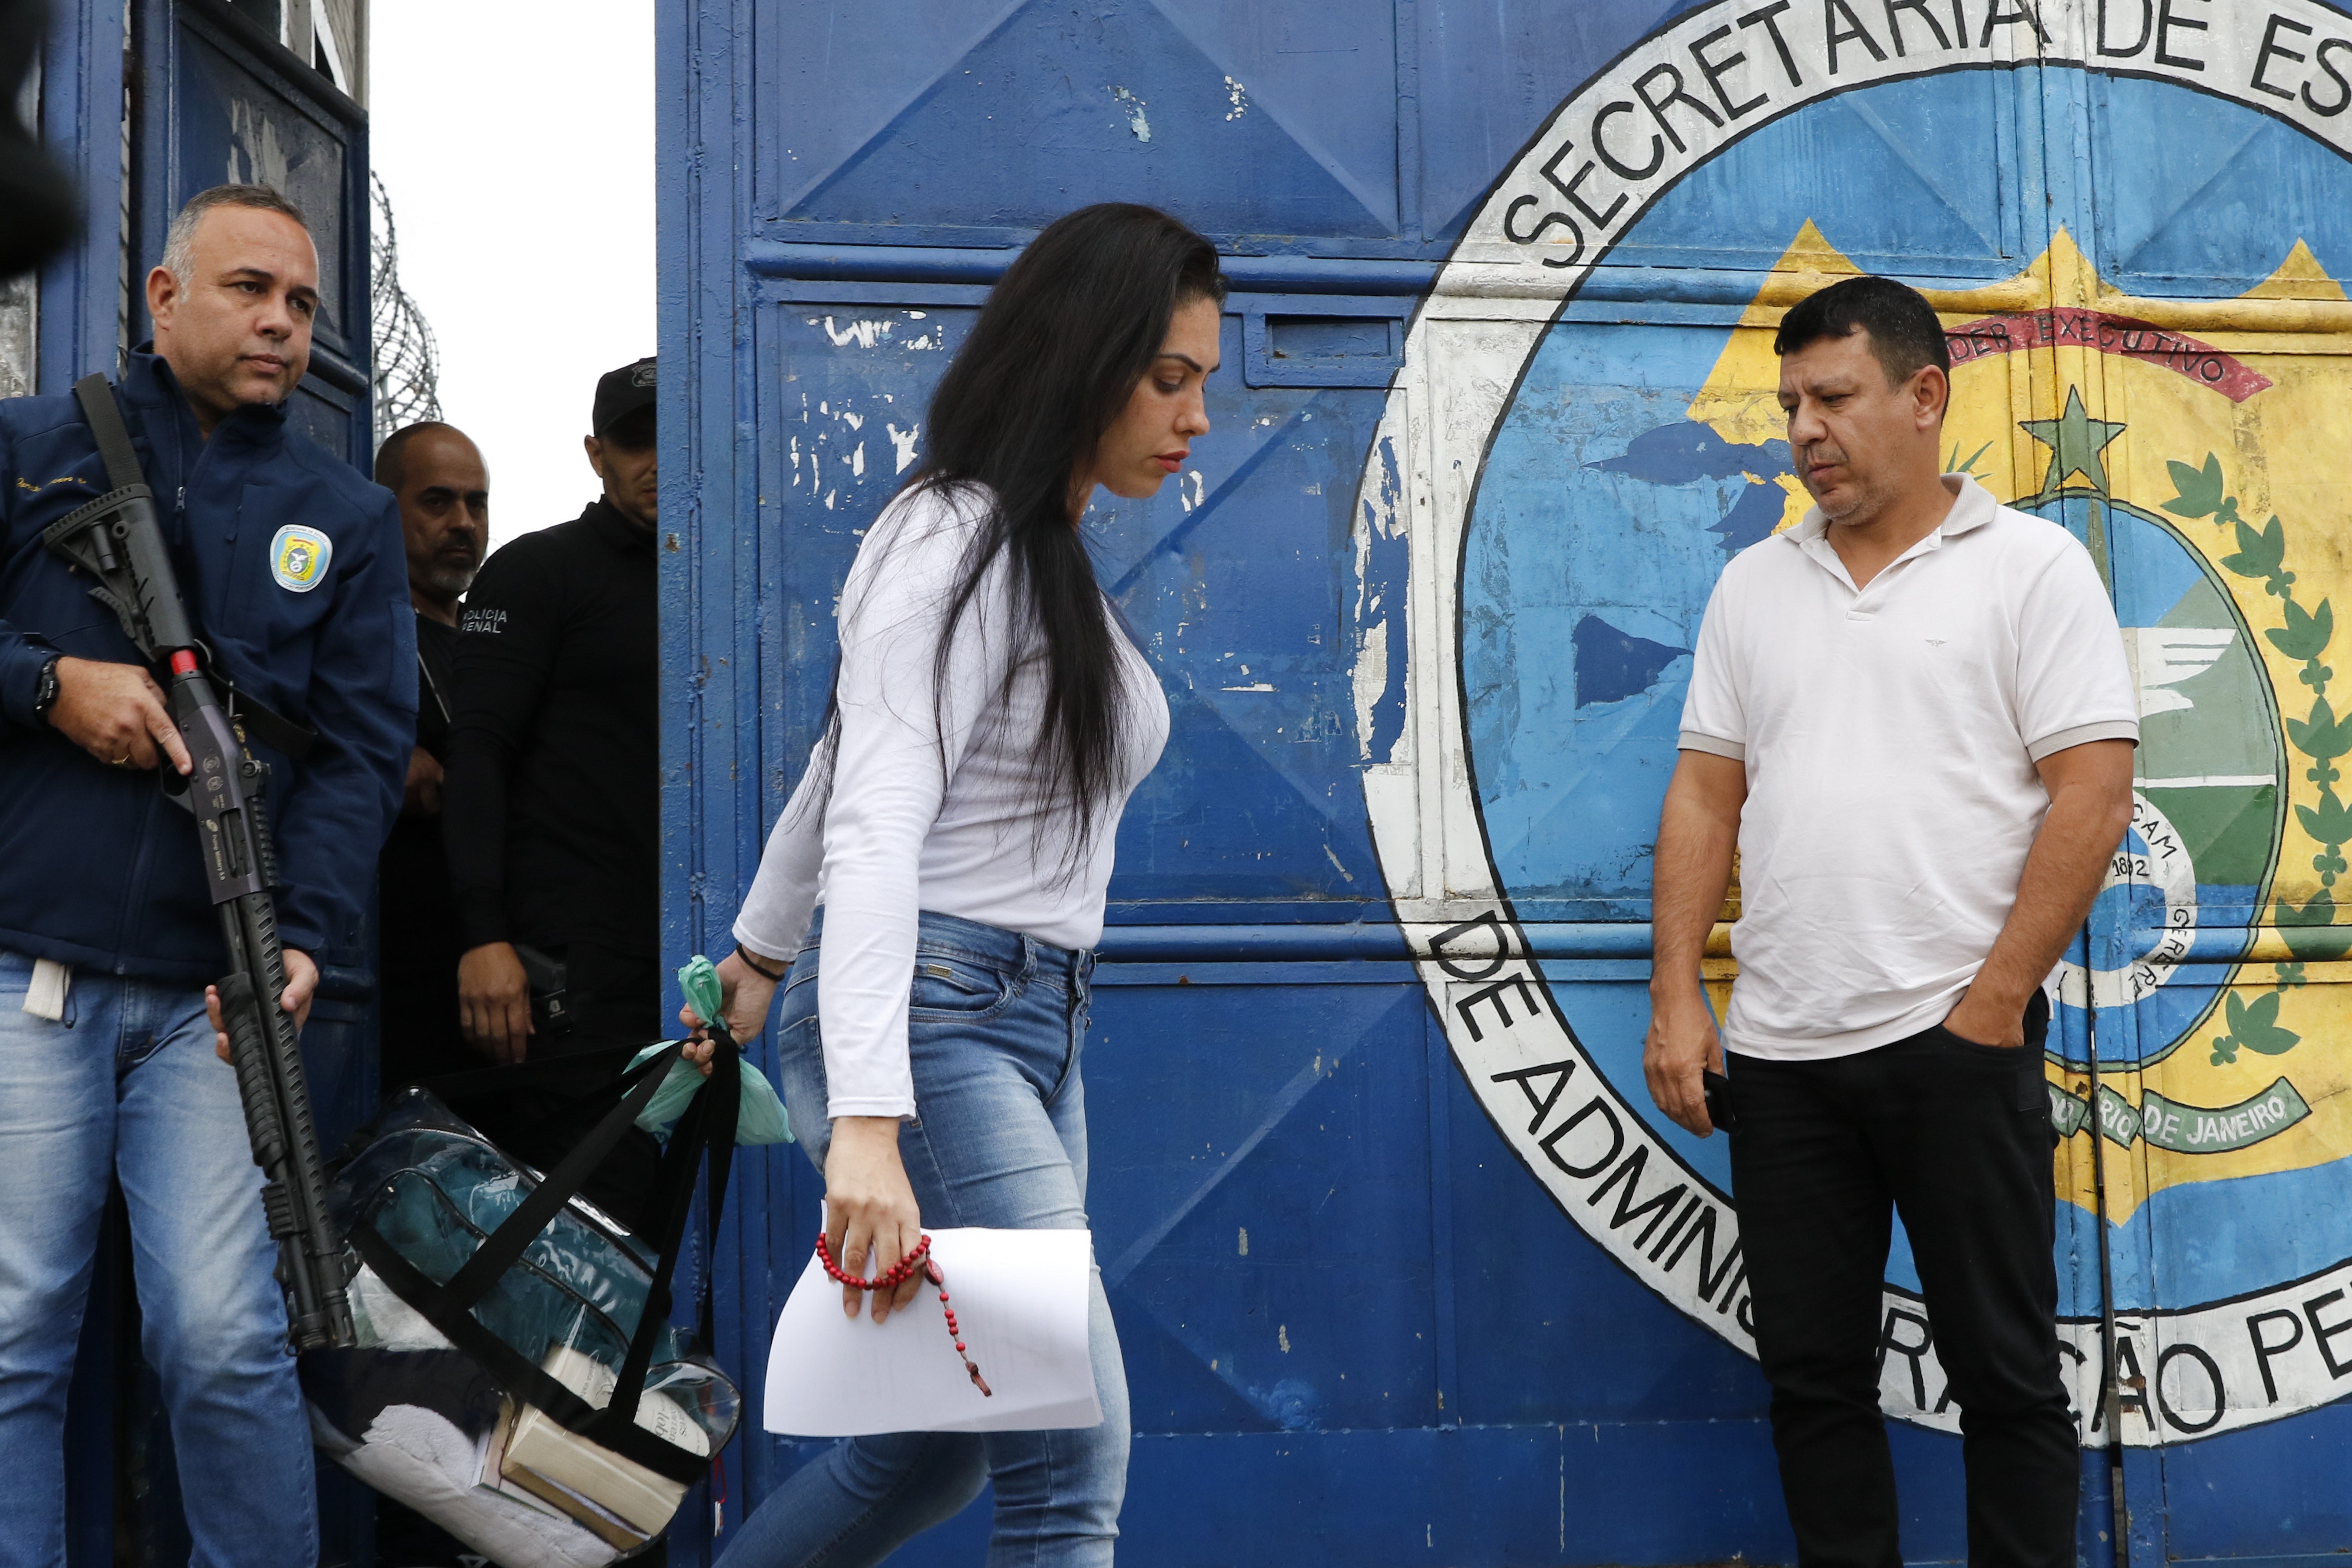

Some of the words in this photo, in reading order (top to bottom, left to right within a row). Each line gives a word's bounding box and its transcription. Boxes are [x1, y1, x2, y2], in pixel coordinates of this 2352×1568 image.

[1504, 0, 2052, 269] SECRETARIA
[2097, 0, 2210, 71] DE
[1946, 323, 2012, 361] DER
[2038, 314, 2224, 382] EXECUTIVO
[2132, 803, 2177, 859] CAM
[2099, 1098, 2132, 1138] RIO
[2144, 1104, 2180, 1144] DE
[2186, 1095, 2287, 1145] JANEIRO
[1428, 910, 1540, 1043] DE
[2247, 1282, 2352, 1407] PE
